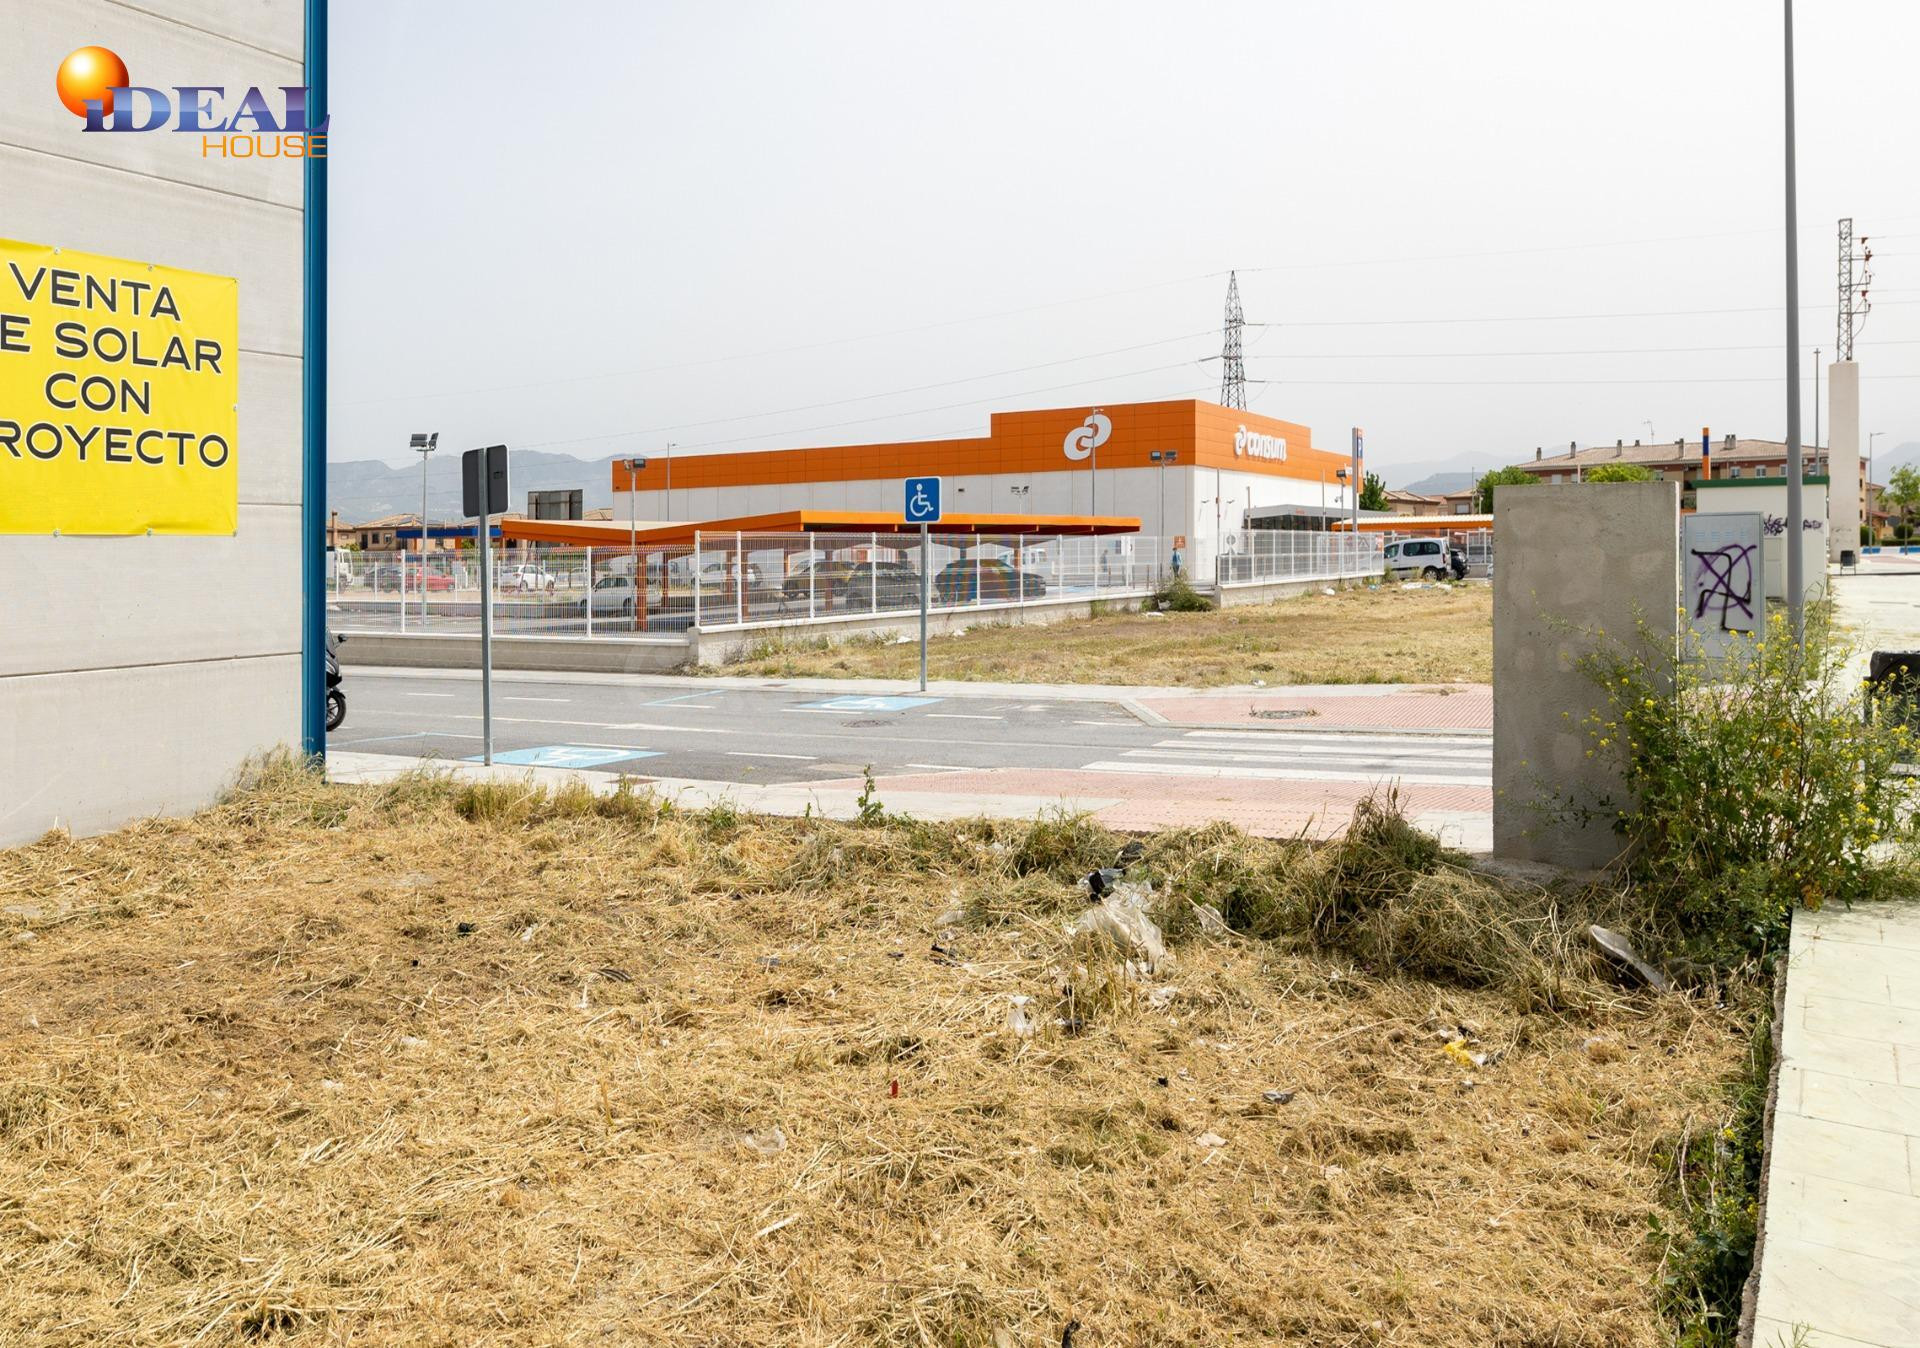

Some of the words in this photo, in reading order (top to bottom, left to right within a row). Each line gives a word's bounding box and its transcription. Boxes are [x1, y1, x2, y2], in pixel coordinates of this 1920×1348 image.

[9, 262, 181, 321] VENTA
[55, 322, 222, 374] SOLAR
[45, 373, 150, 414] CON
